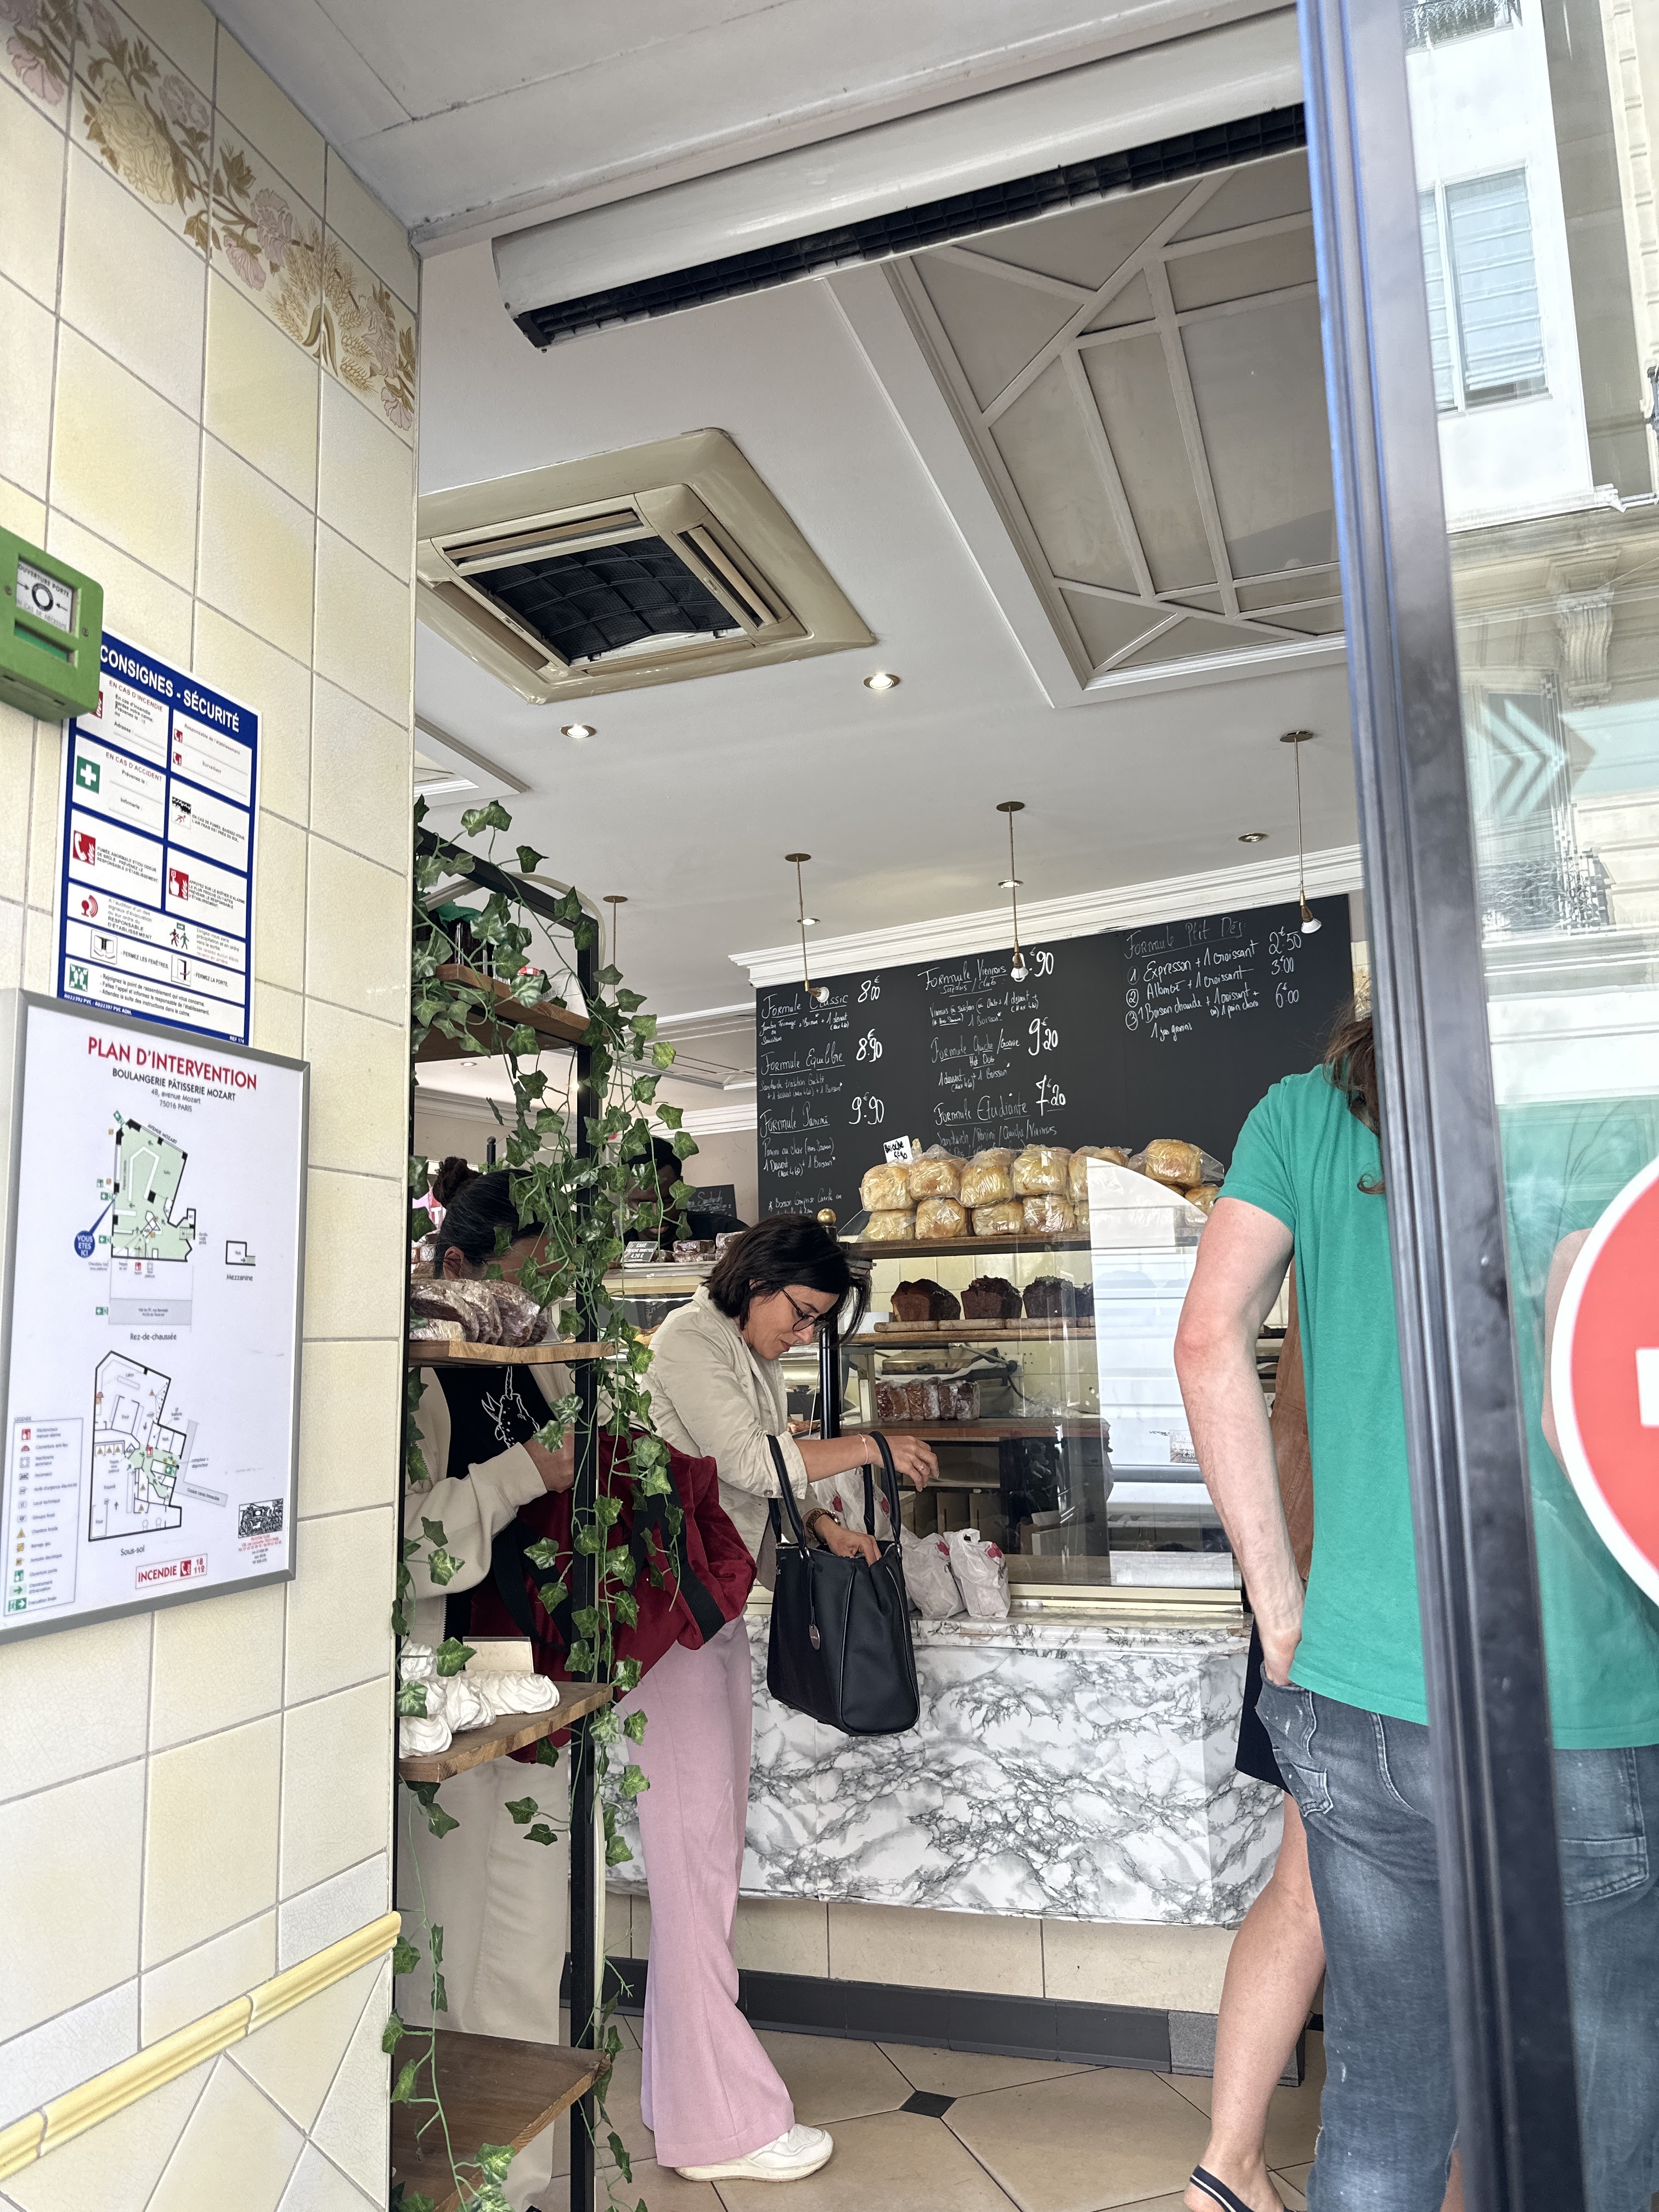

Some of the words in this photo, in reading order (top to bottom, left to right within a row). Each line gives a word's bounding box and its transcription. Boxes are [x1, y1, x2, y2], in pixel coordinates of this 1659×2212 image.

[52, 583, 70, 597] PORTE
[100, 645, 173, 697] CONSIGNES
[183, 689, 240, 732] SÉCURITÉ
[109, 680, 117, 689] EN
[119, 684, 131, 696] CAS
[132, 692, 163, 712] D'INCENDIE
[115, 755, 127, 766] CAS
[129, 761, 162, 782] D'ACCIDENT
[88, 1036, 131, 1063] PLAN
[137, 1048, 257, 1091] D'INTERVENTION
[112, 1068, 166, 1087] BOULANGERIE
[168, 1079, 205, 1095] PÂTISSERIE
[207, 1090, 235, 1101] MOZART
[151, 1088, 160, 1097] 48,
[161, 1092, 181, 1100] avenue
[183, 1094, 201, 1104] Mozart
[160, 1099, 177, 1109] 75016
[178, 1104, 192, 1112] PARIS
[130, 1333, 177, 1341] Rez-de-chaussée
[120, 1545, 145, 1556] Sous-sol
[196, 1558, 204, 1566] 18
[138, 1565, 177, 1583] INCENDIE
[194, 1566, 205, 1575] 112
